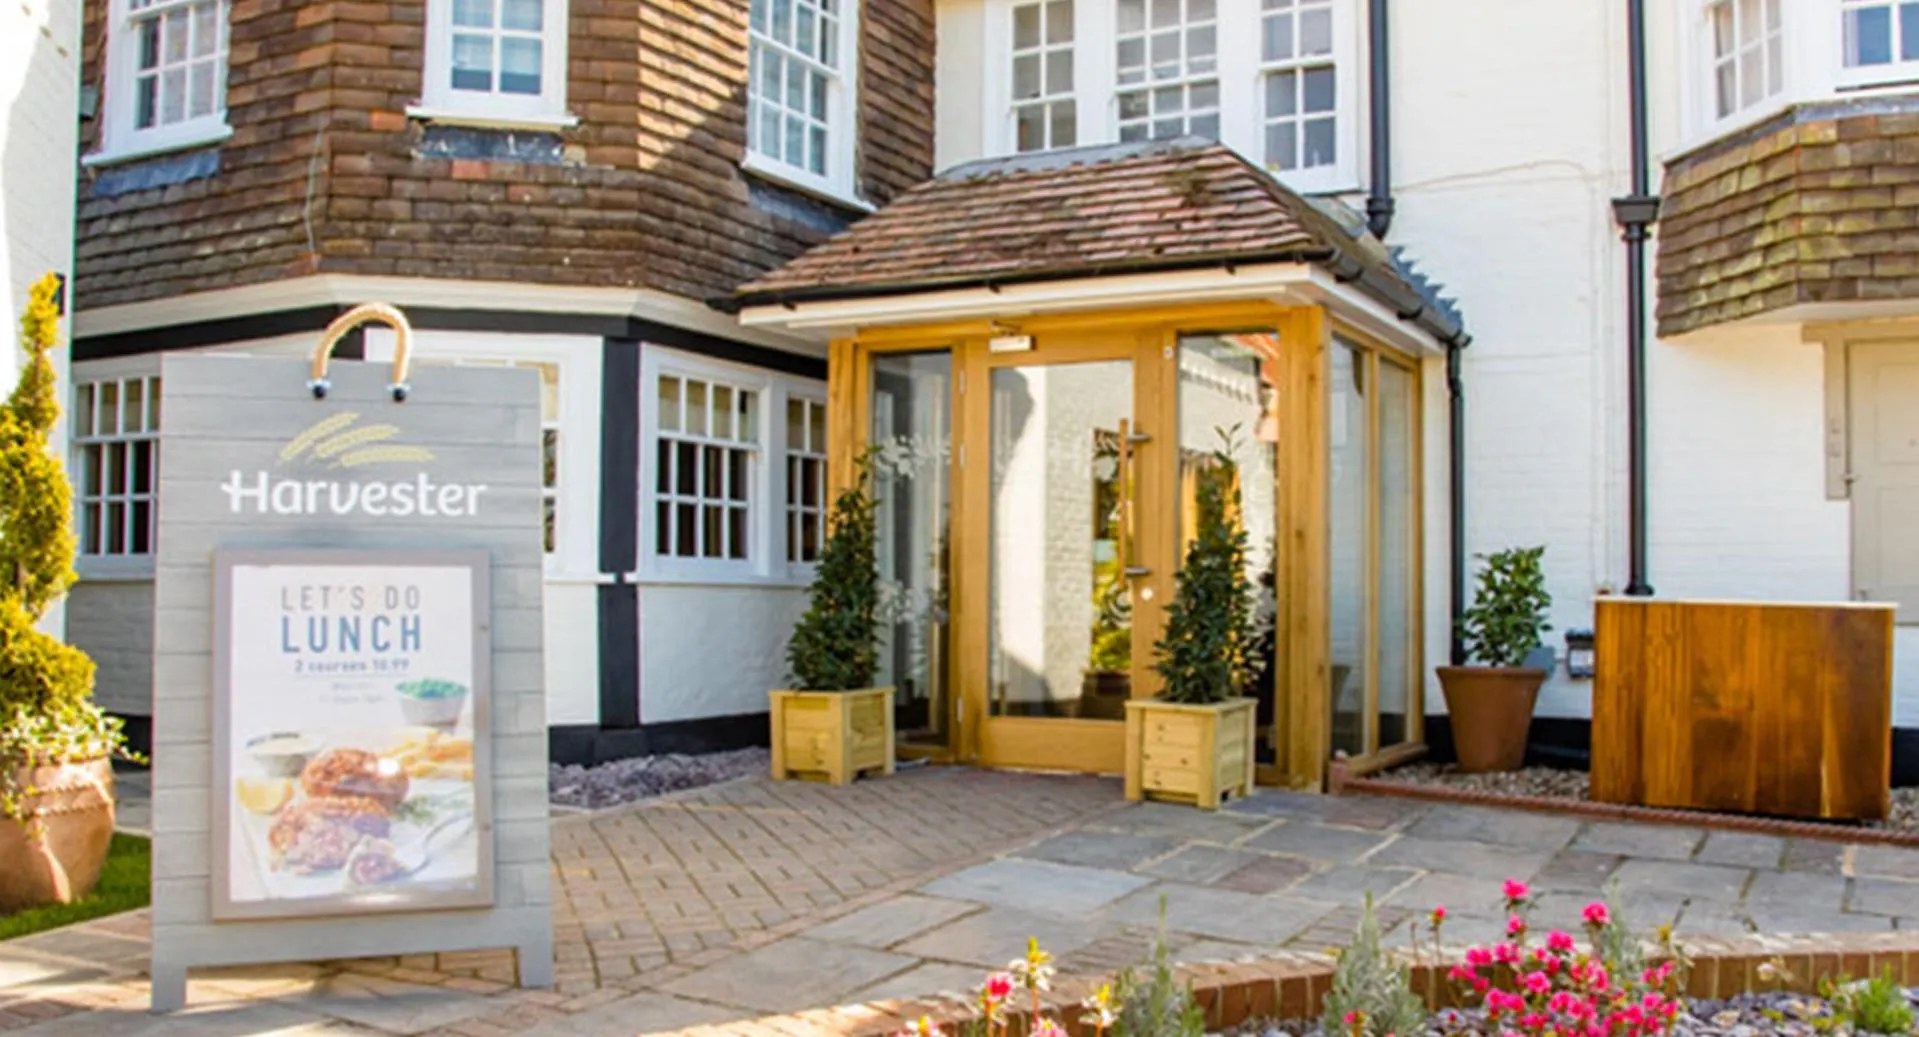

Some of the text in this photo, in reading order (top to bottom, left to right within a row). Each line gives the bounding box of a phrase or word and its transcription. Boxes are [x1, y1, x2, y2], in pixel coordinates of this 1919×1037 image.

[220, 469, 488, 516] Harvester
[281, 585, 420, 610] LET'S DO
[282, 615, 420, 653] LUNCH
[295, 659, 303, 672] 2
